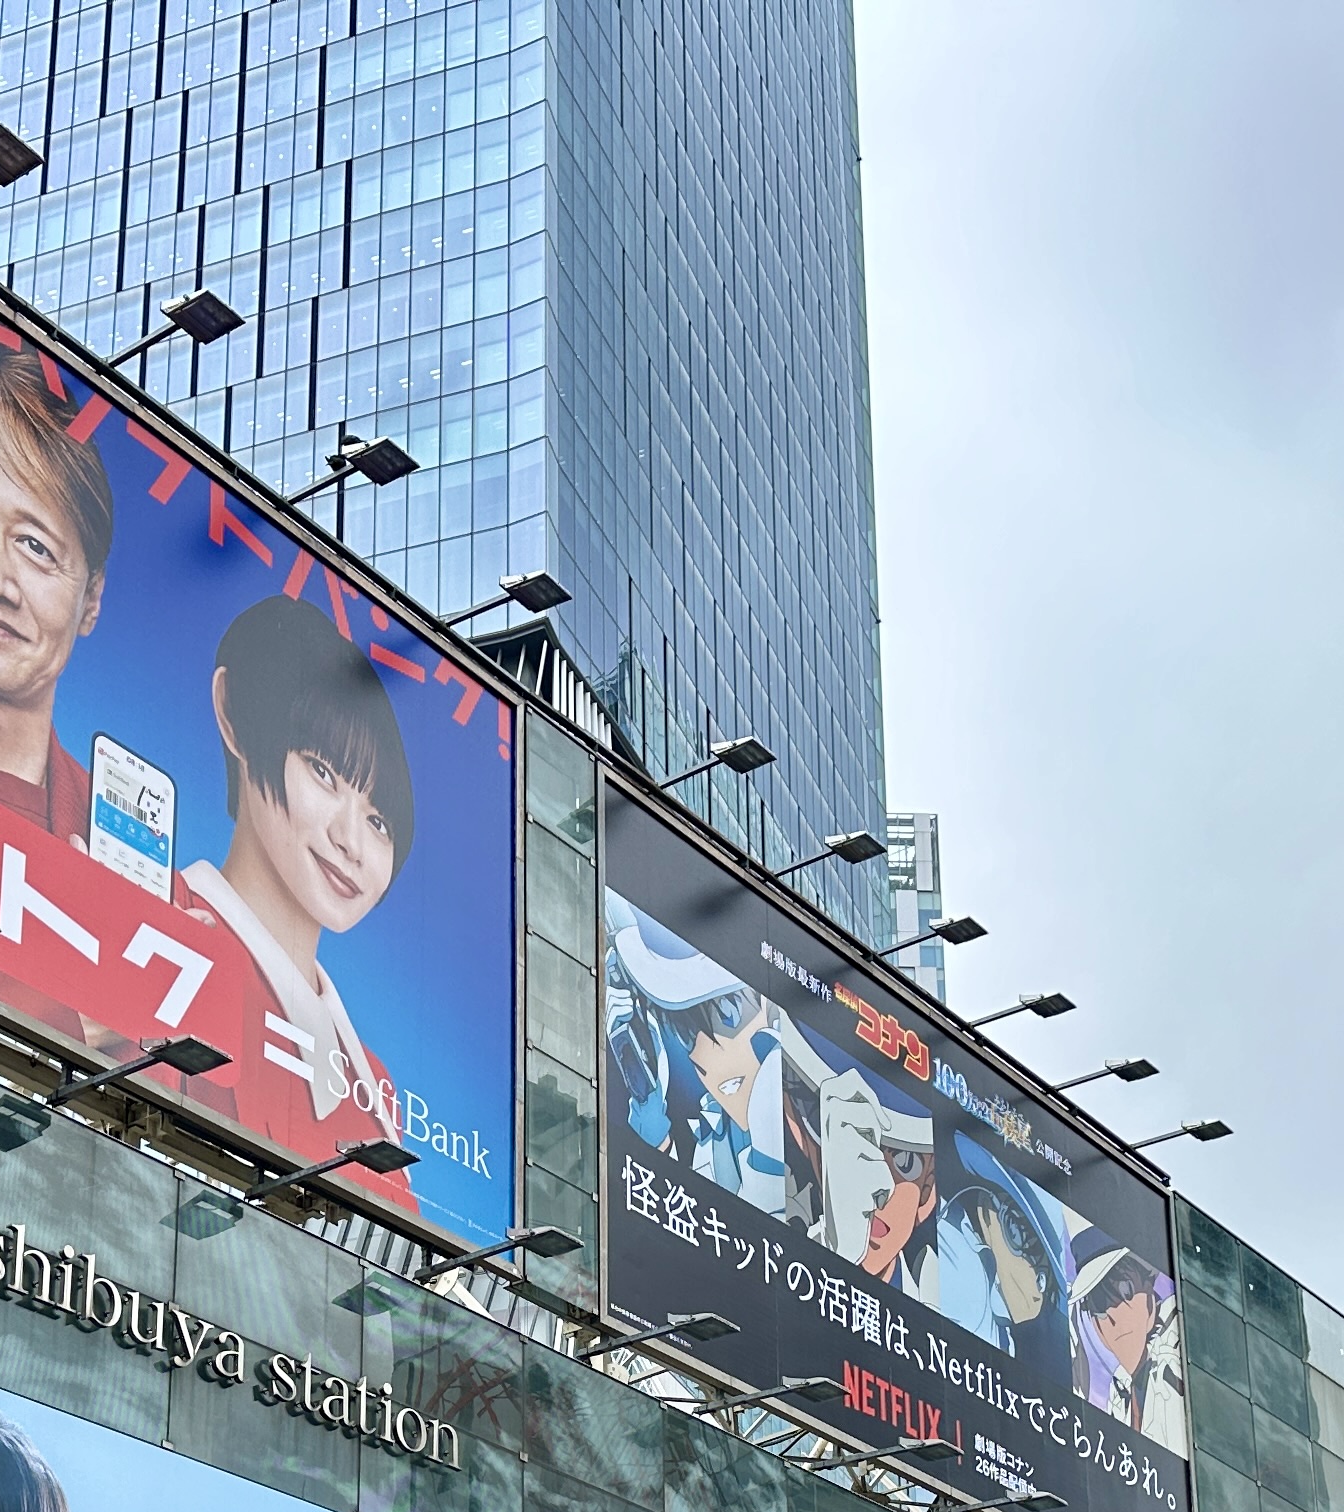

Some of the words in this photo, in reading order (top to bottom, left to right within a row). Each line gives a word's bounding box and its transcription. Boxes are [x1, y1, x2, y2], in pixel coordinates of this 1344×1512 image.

[327, 1049, 492, 1181] SoftBank
[270, 1351, 462, 1472] station
[843, 1359, 943, 1441] NETFLIX
